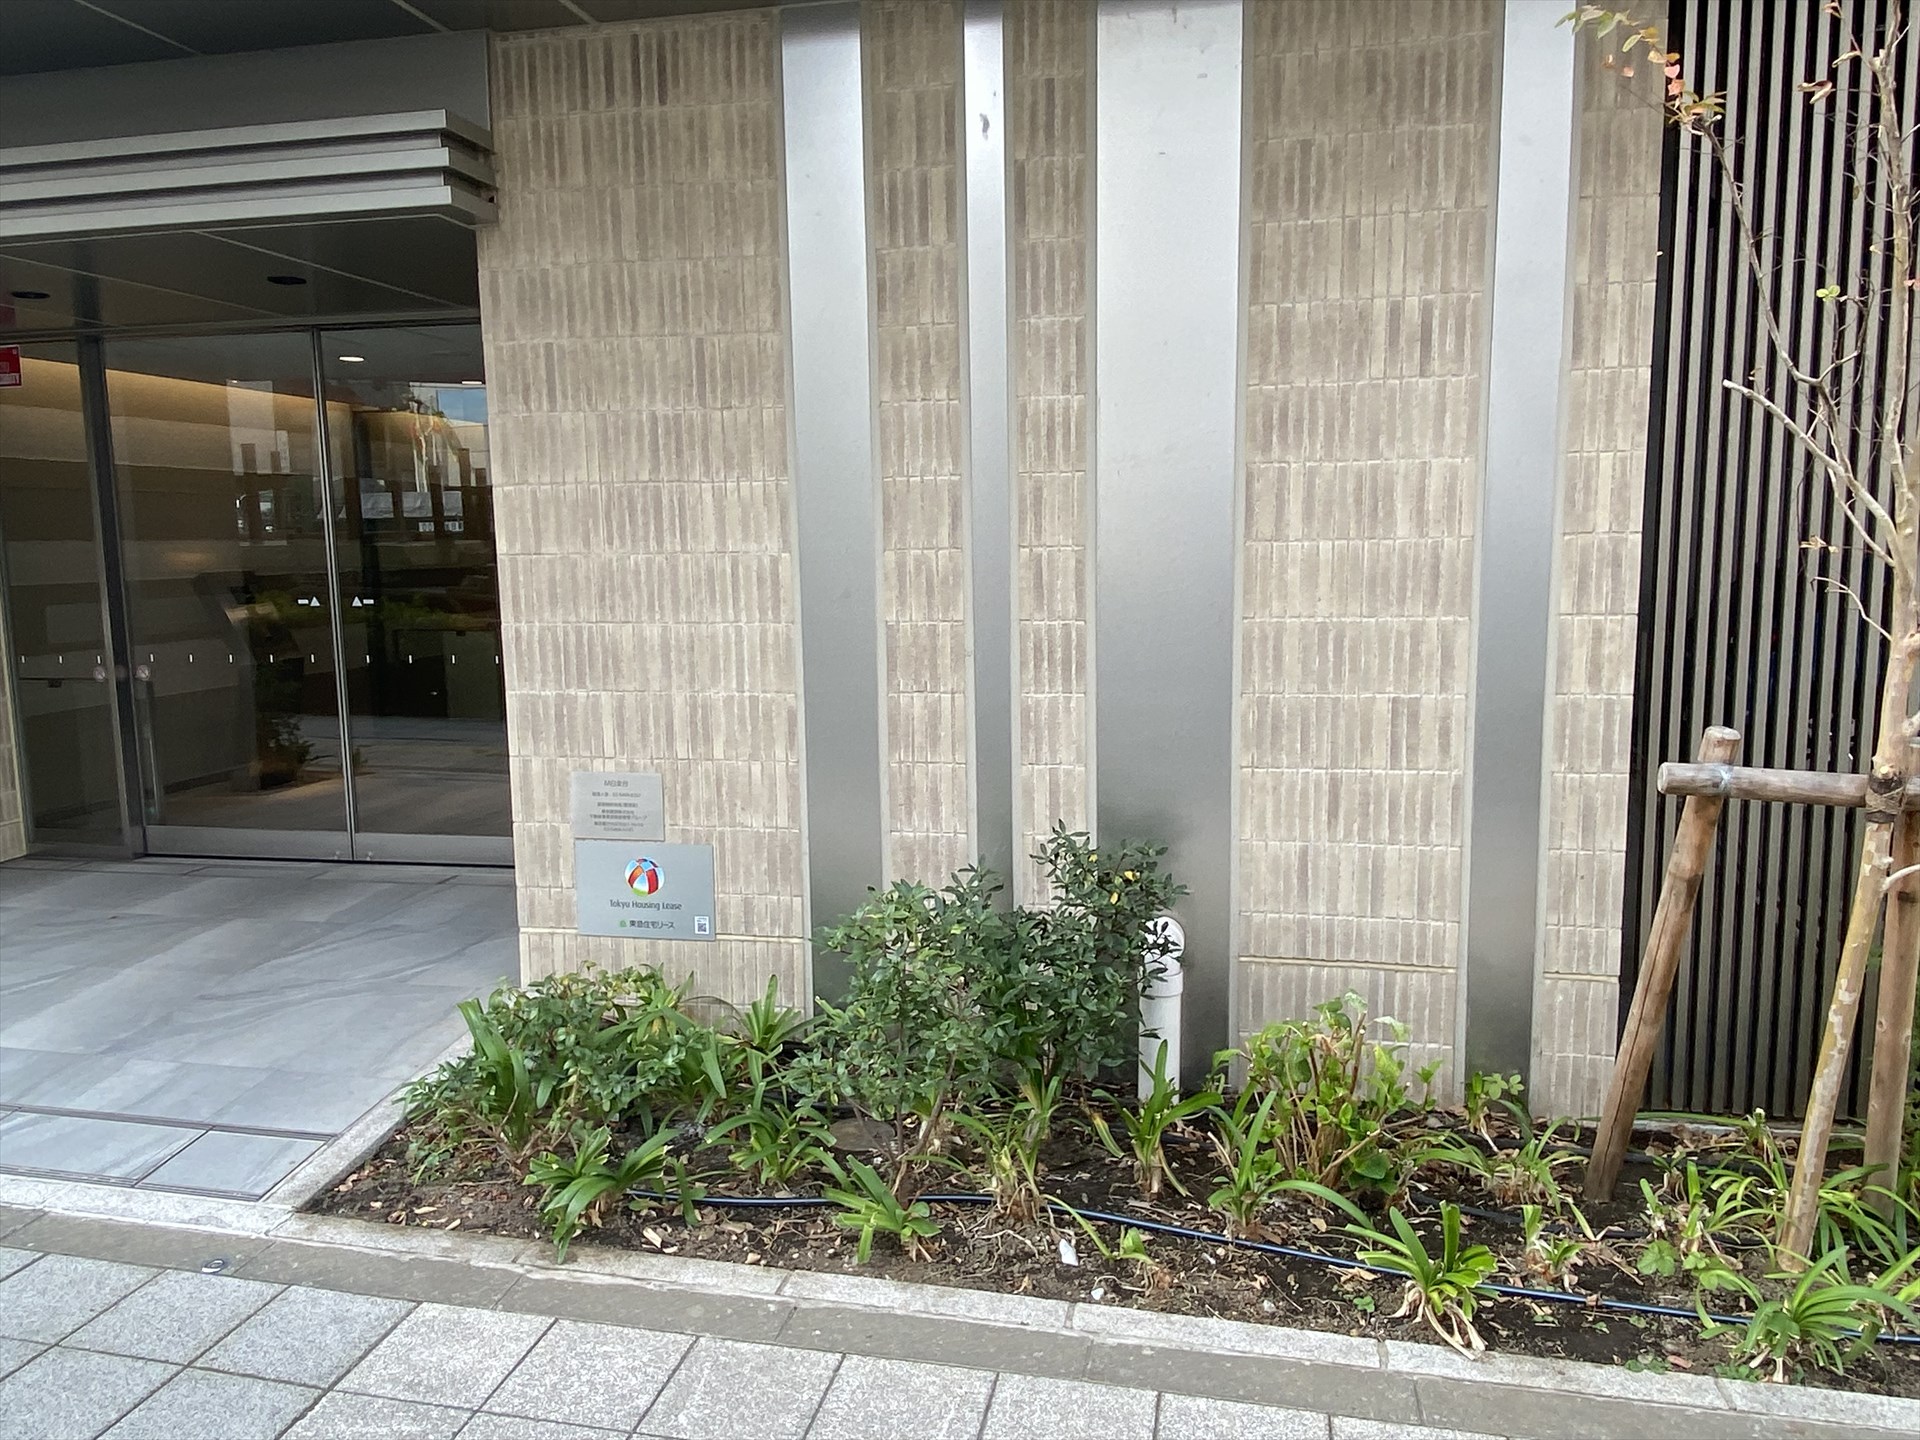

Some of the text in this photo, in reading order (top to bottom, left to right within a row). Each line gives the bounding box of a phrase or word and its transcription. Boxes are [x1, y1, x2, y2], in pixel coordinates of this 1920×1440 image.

[609, 899, 682, 911] Tokyu Housing Lease
[629, 920, 675, 929] 東急住宅リース
